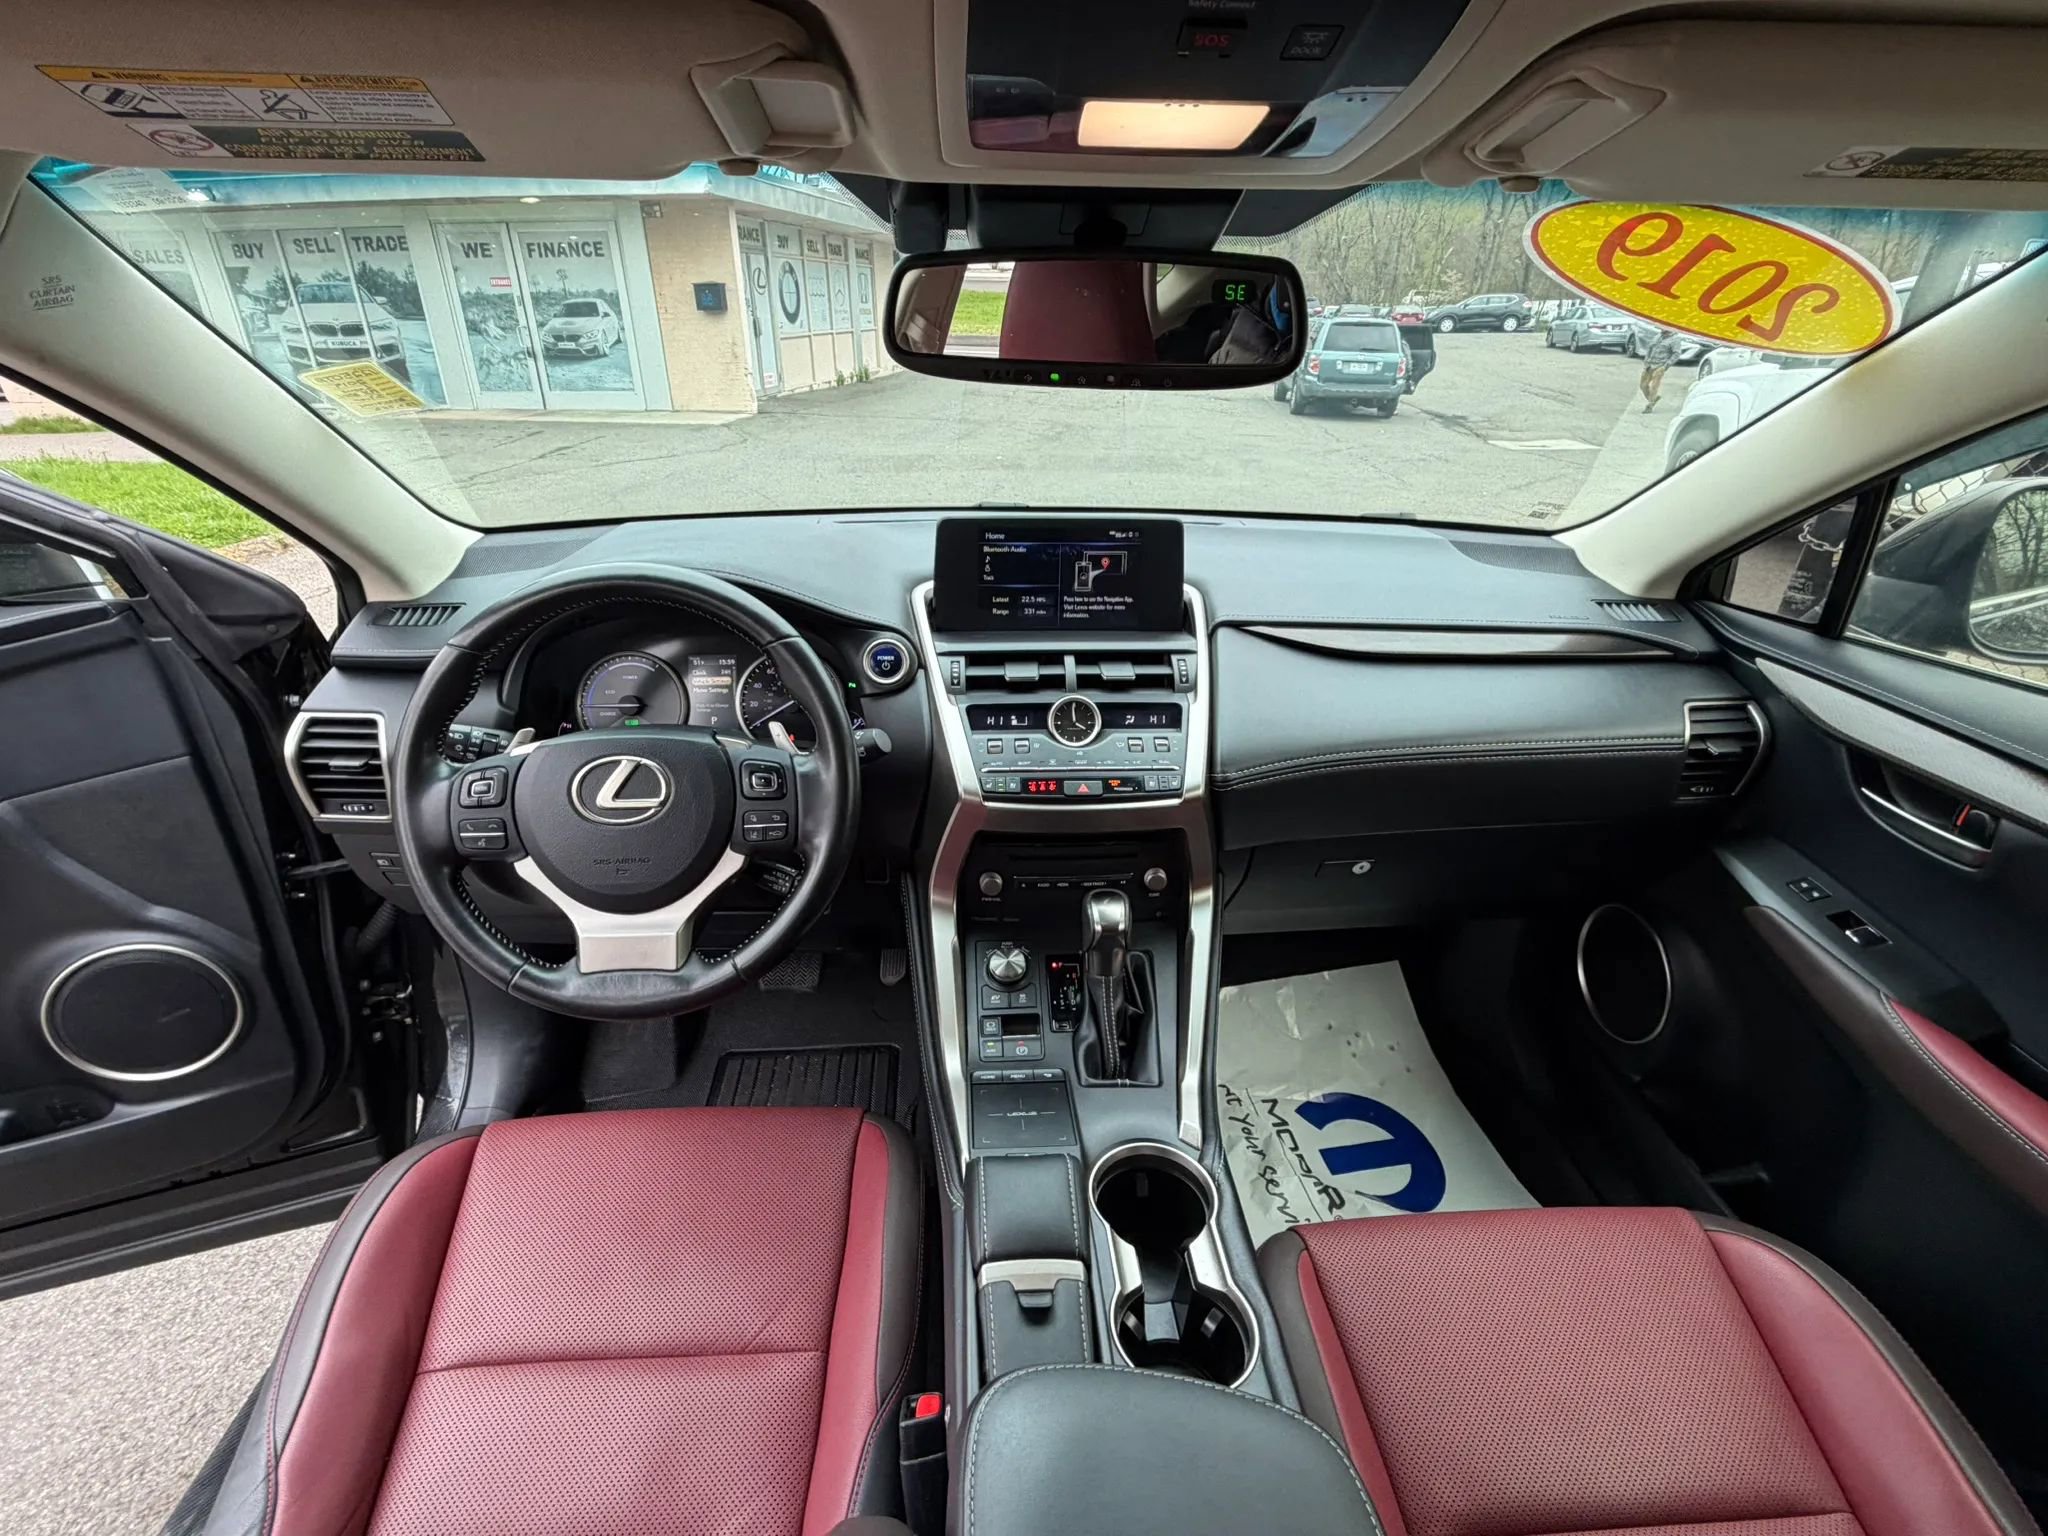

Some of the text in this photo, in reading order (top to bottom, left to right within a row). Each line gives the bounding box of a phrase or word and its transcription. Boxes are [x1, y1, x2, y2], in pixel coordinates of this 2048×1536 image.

[1194, 34, 1232, 47] SOS
[232, 235, 410, 259] BUY SELL TRADE
[460, 241, 605, 258] WE FINANCE
[806, 239, 819, 253] SELL
[135, 250, 185, 264] SALES
[30, 285, 75, 299] CURTAIN
[1225, 284, 1246, 301] SE
[985, 532, 1005, 540] Home
[711, 716, 718, 725] P
[1261, 1098, 1346, 1215] MOPAR
